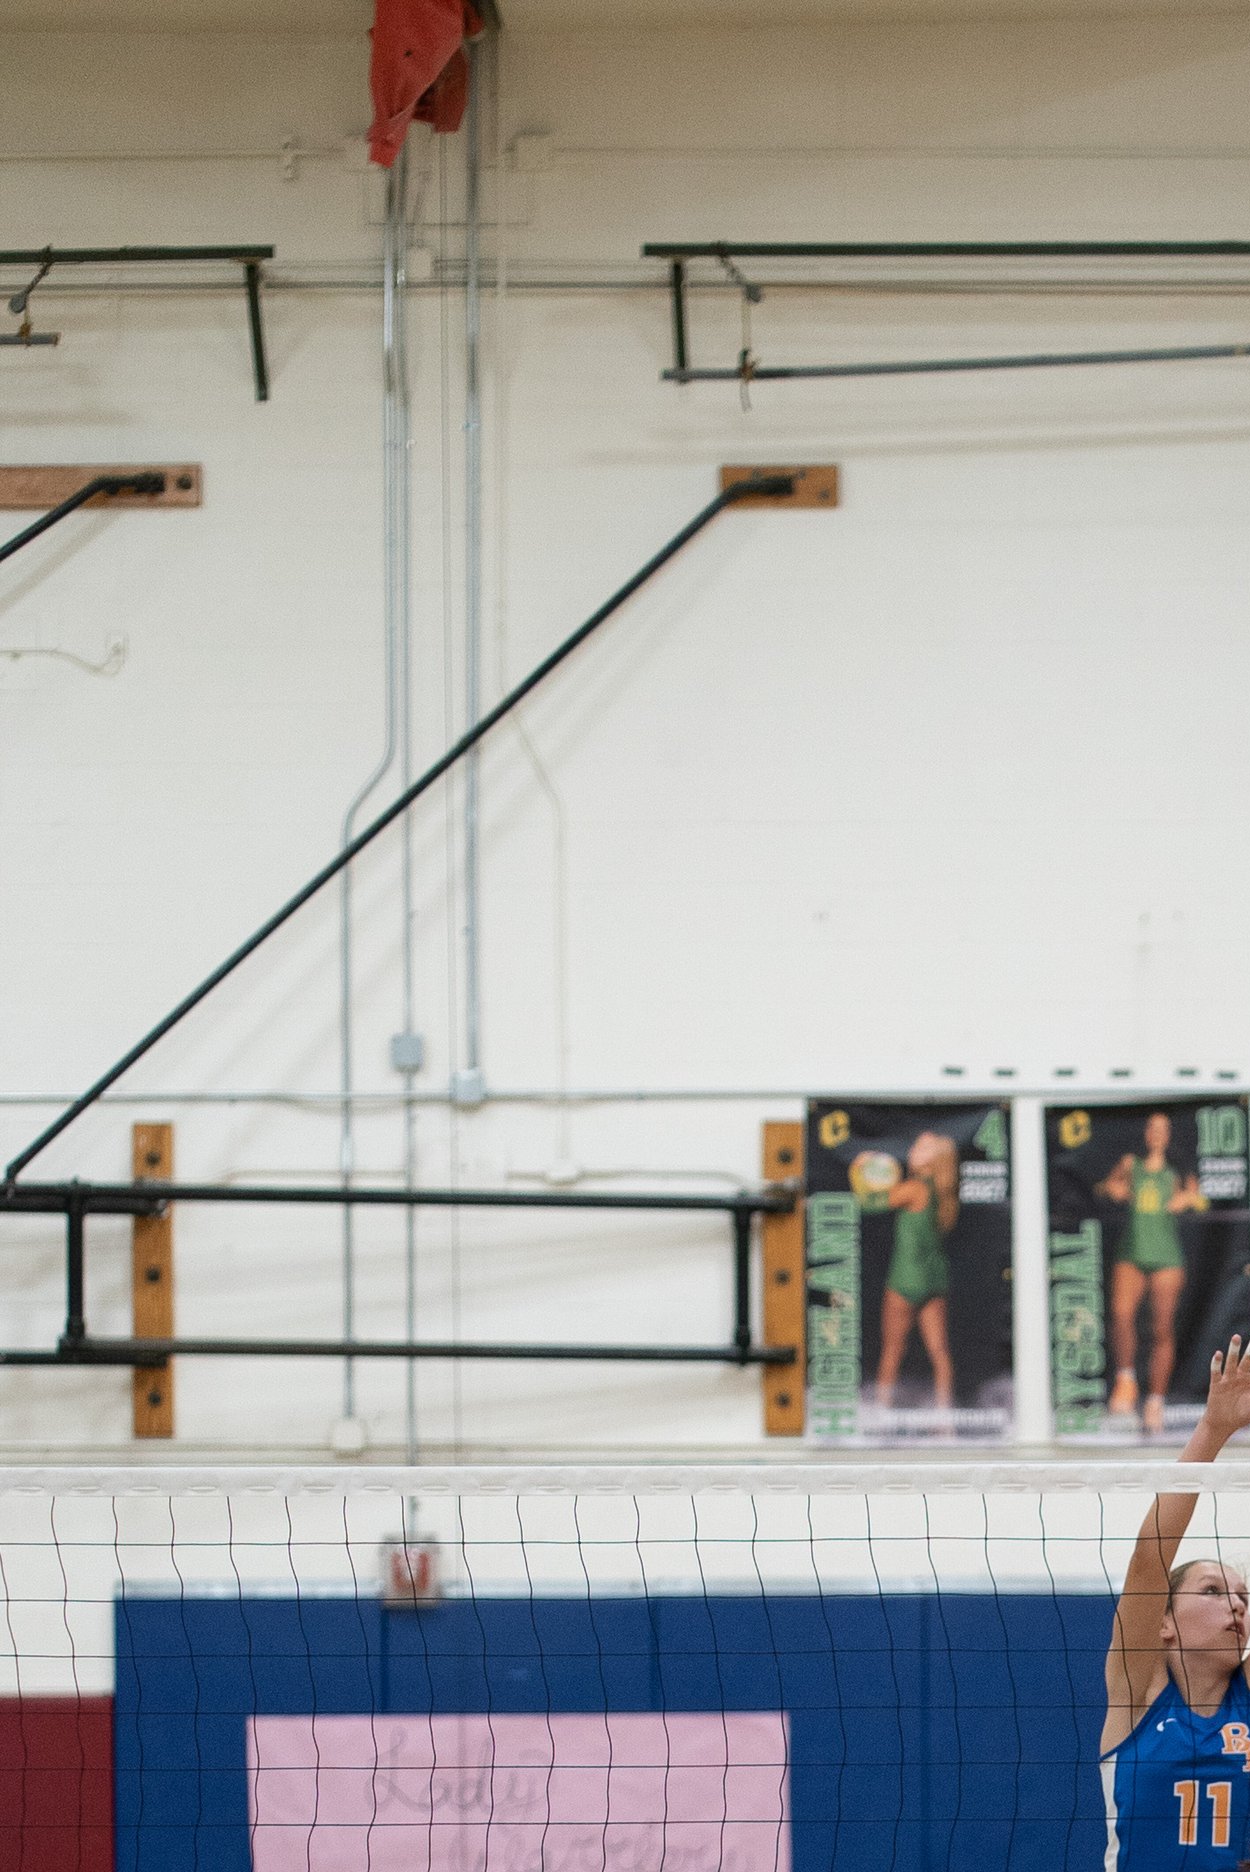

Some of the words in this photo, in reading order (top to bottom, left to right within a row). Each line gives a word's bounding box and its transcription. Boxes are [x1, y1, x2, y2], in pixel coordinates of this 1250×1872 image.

[973, 1109, 1008, 1160] 4
[1195, 1106, 1248, 1157] 10
[806, 1192, 862, 1436] HIGHLAND
[1050, 1219, 1107, 1434] RYSSDAL
[1174, 1780, 1233, 1847] 11
